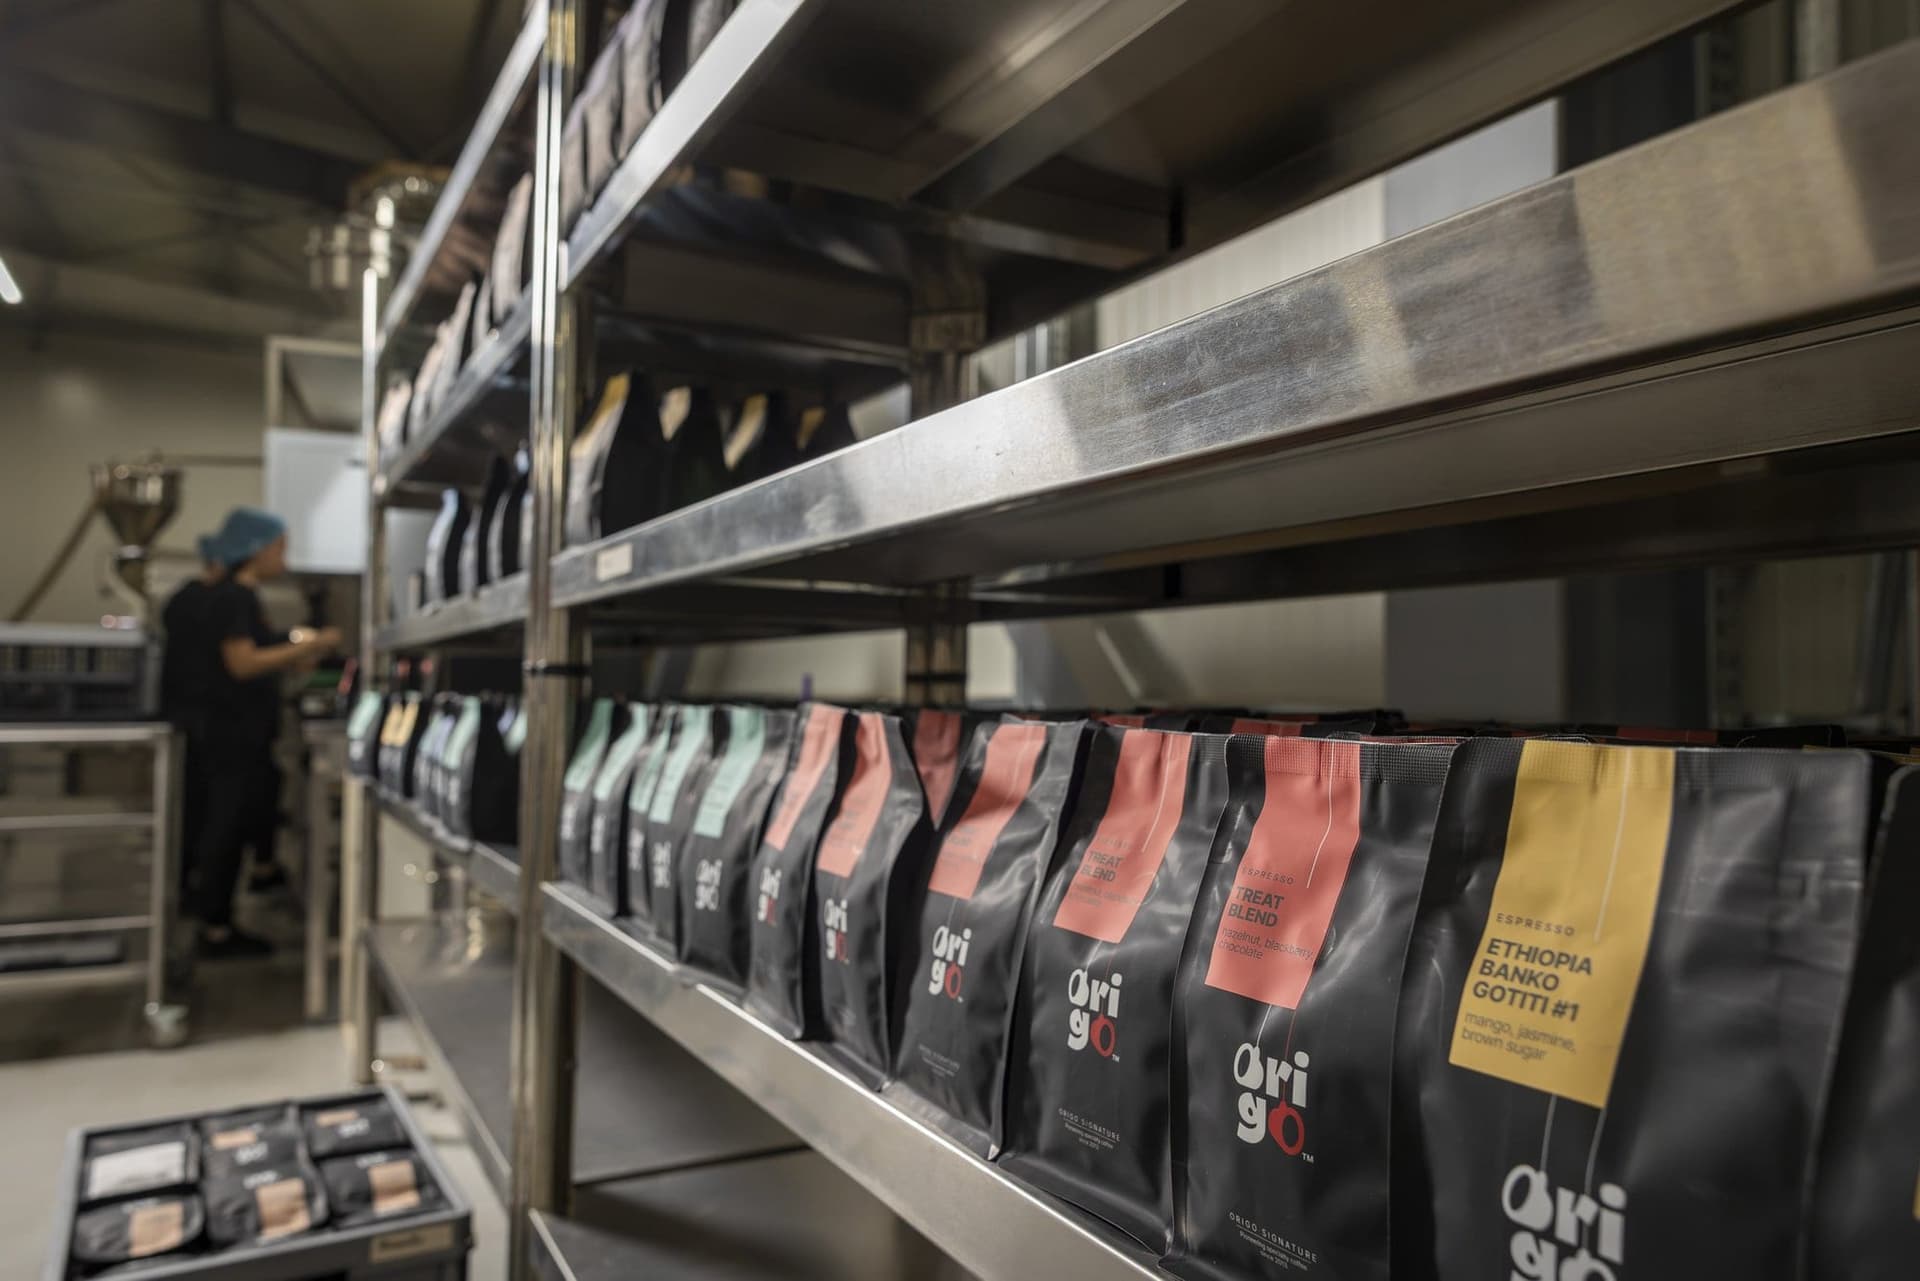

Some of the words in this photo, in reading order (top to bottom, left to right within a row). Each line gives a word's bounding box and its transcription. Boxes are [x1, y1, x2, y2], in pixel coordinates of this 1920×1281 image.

[1228, 903, 1279, 927] BLEND
[1235, 886, 1285, 910] TREAT
[1496, 913, 1575, 936] ESPRESSO
[1479, 958, 1560, 991] BANKO
[1486, 937, 1592, 975] ETHIOPIA
[1068, 968, 1122, 1018] Ori
[1473, 981, 1549, 1015] GOTITI
[1552, 999, 1579, 1022] #1
[1067, 1008, 1116, 1057] go
[1462, 1028, 1503, 1048] brown
[1506, 1038, 1547, 1060] sugar
[1464, 1012, 1513, 1035] mango,
[1517, 1023, 1577, 1055] jasmine,
[1233, 1042, 1309, 1108] Ori
[1237, 1092, 1305, 1156] go
[1502, 1164, 1627, 1266] Ori
[1229, 1211, 1258, 1232] ORIGO
[1261, 1228, 1319, 1263] SIGNATURE
